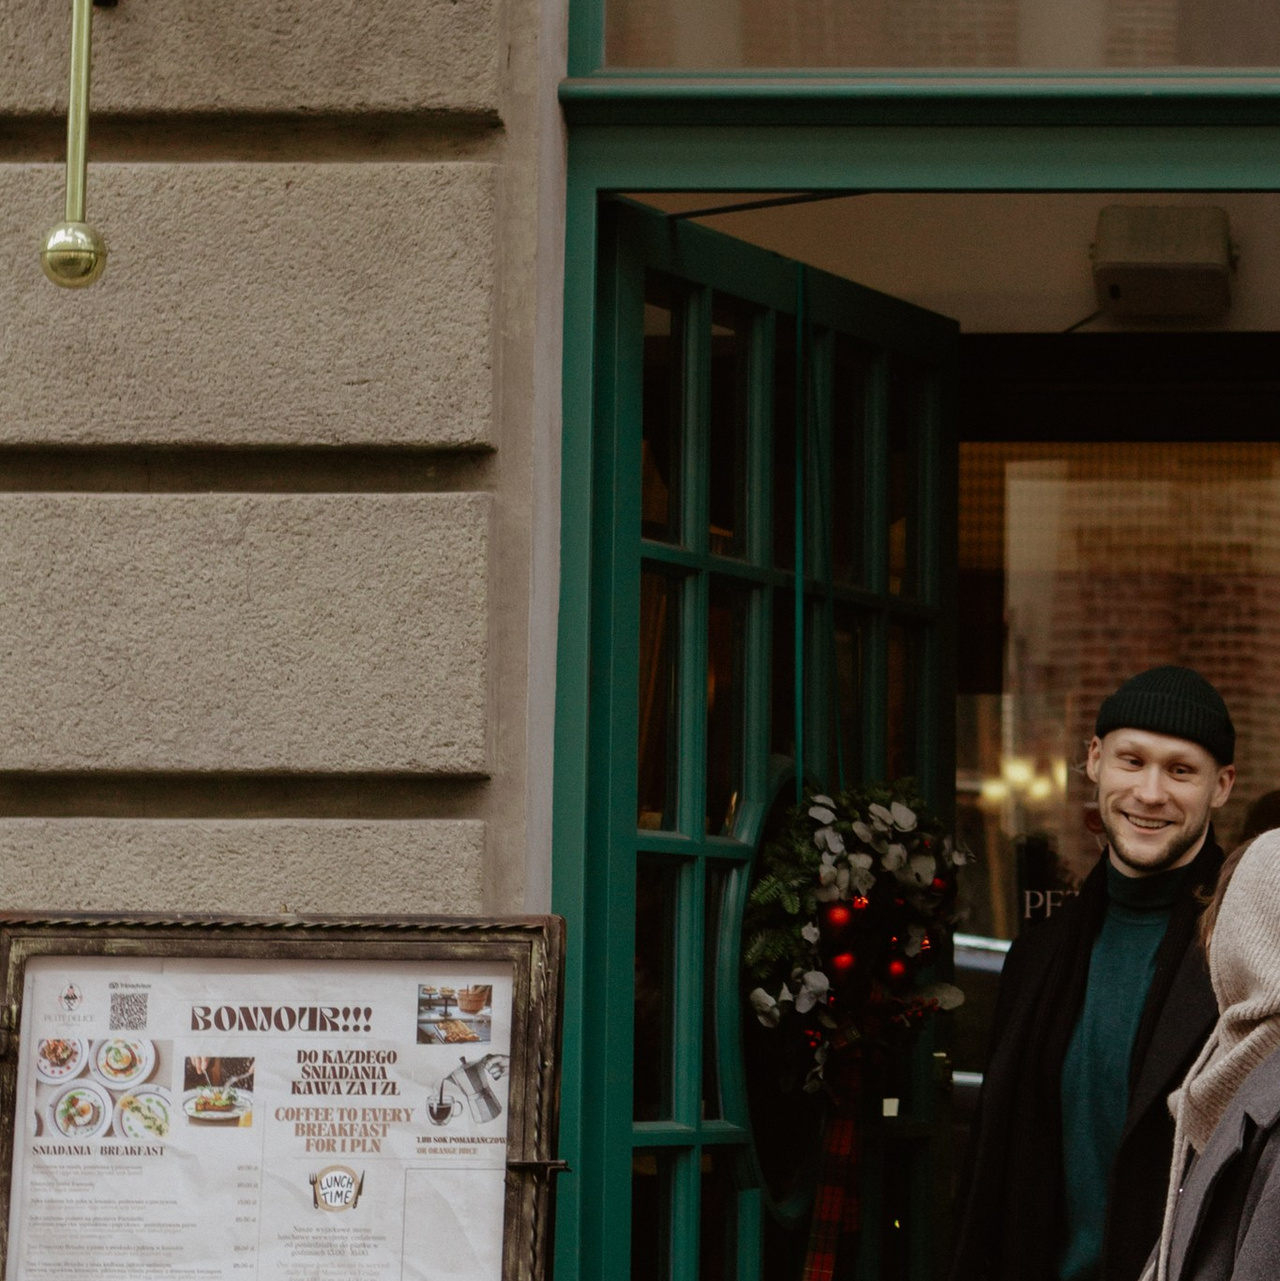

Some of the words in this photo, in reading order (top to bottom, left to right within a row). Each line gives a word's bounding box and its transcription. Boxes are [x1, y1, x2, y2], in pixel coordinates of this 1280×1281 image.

[191, 1006, 373, 1032] BONJOUR!!!
[296, 1050, 319, 1064] DO
[291, 1081, 342, 1095] KAWA
[346, 1081, 367, 1095] ZA
[274, 1107, 334, 1122] COFFEE
[336, 1107, 358, 1122] TO
[361, 1107, 415, 1123] EVERY
[294, 1123, 390, 1137] BREAKFAST
[305, 1138, 339, 1153] FOR
[350, 1138, 382, 1153] PLN
[433, 1136, 447, 1144] SOK
[100, 1145, 165, 1156] BREAKFAST
[428, 1147, 457, 1155] ORANGE
[320, 1175, 354, 1191] LUNCH
[322, 1190, 352, 1205] TIME
